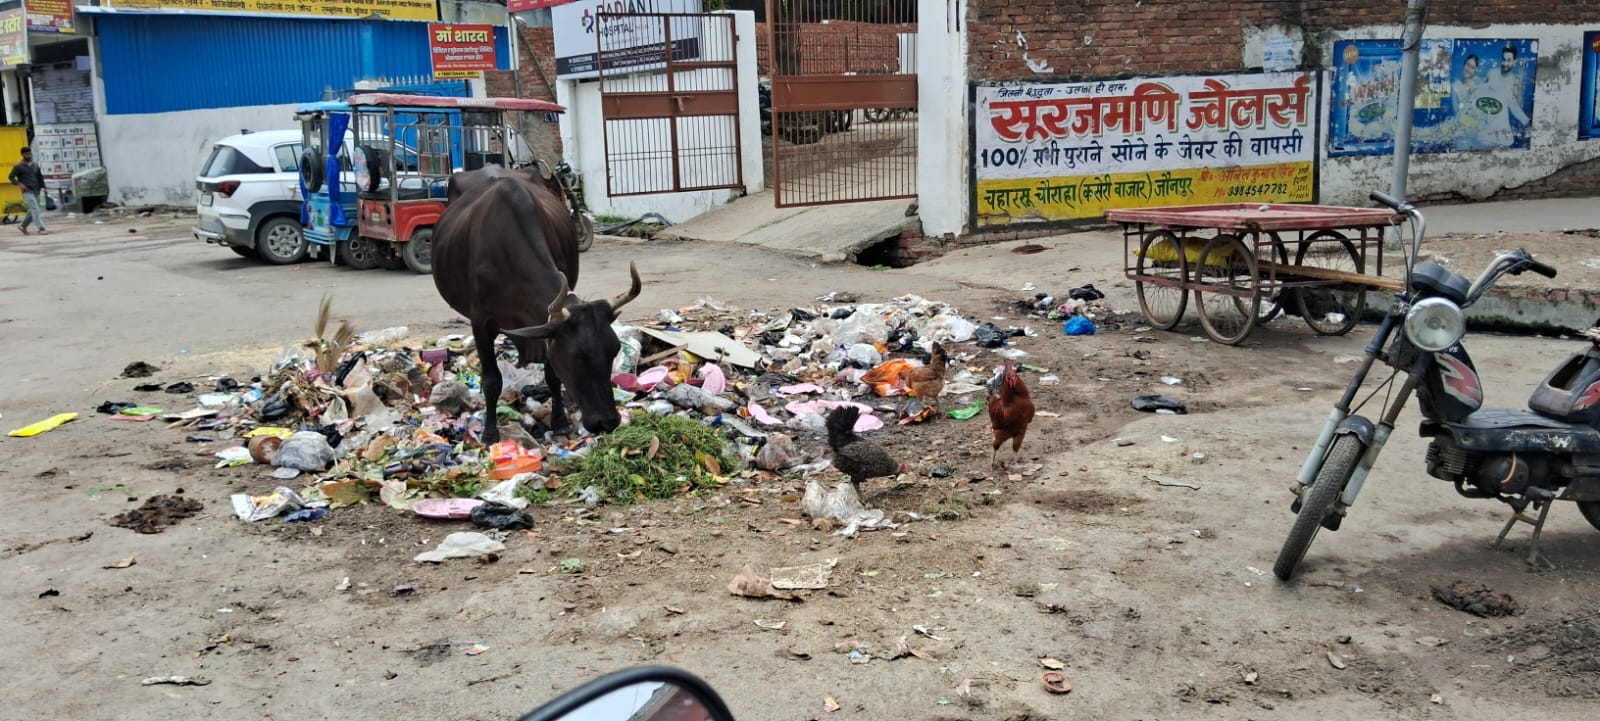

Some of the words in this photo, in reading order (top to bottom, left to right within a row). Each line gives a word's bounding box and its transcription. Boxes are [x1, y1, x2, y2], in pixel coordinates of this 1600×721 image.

[454, 30, 488, 43] शारदा
[989, 83, 1181, 143] सूरजमणि
[1186, 75, 1314, 132] ज्वेलर्स
[981, 146, 1028, 169] 100%
[1063, 140, 1103, 167] पुराने
[1110, 137, 1149, 163] सोने
[1153, 134, 1173, 161] के
[1177, 132, 1218, 160] जेवर
[1223, 129, 1243, 157] की
[1250, 127, 1304, 156] वापसी
[1035, 179, 1078, 210] चौराहा
[1154, 171, 1194, 198] जौनपुर
